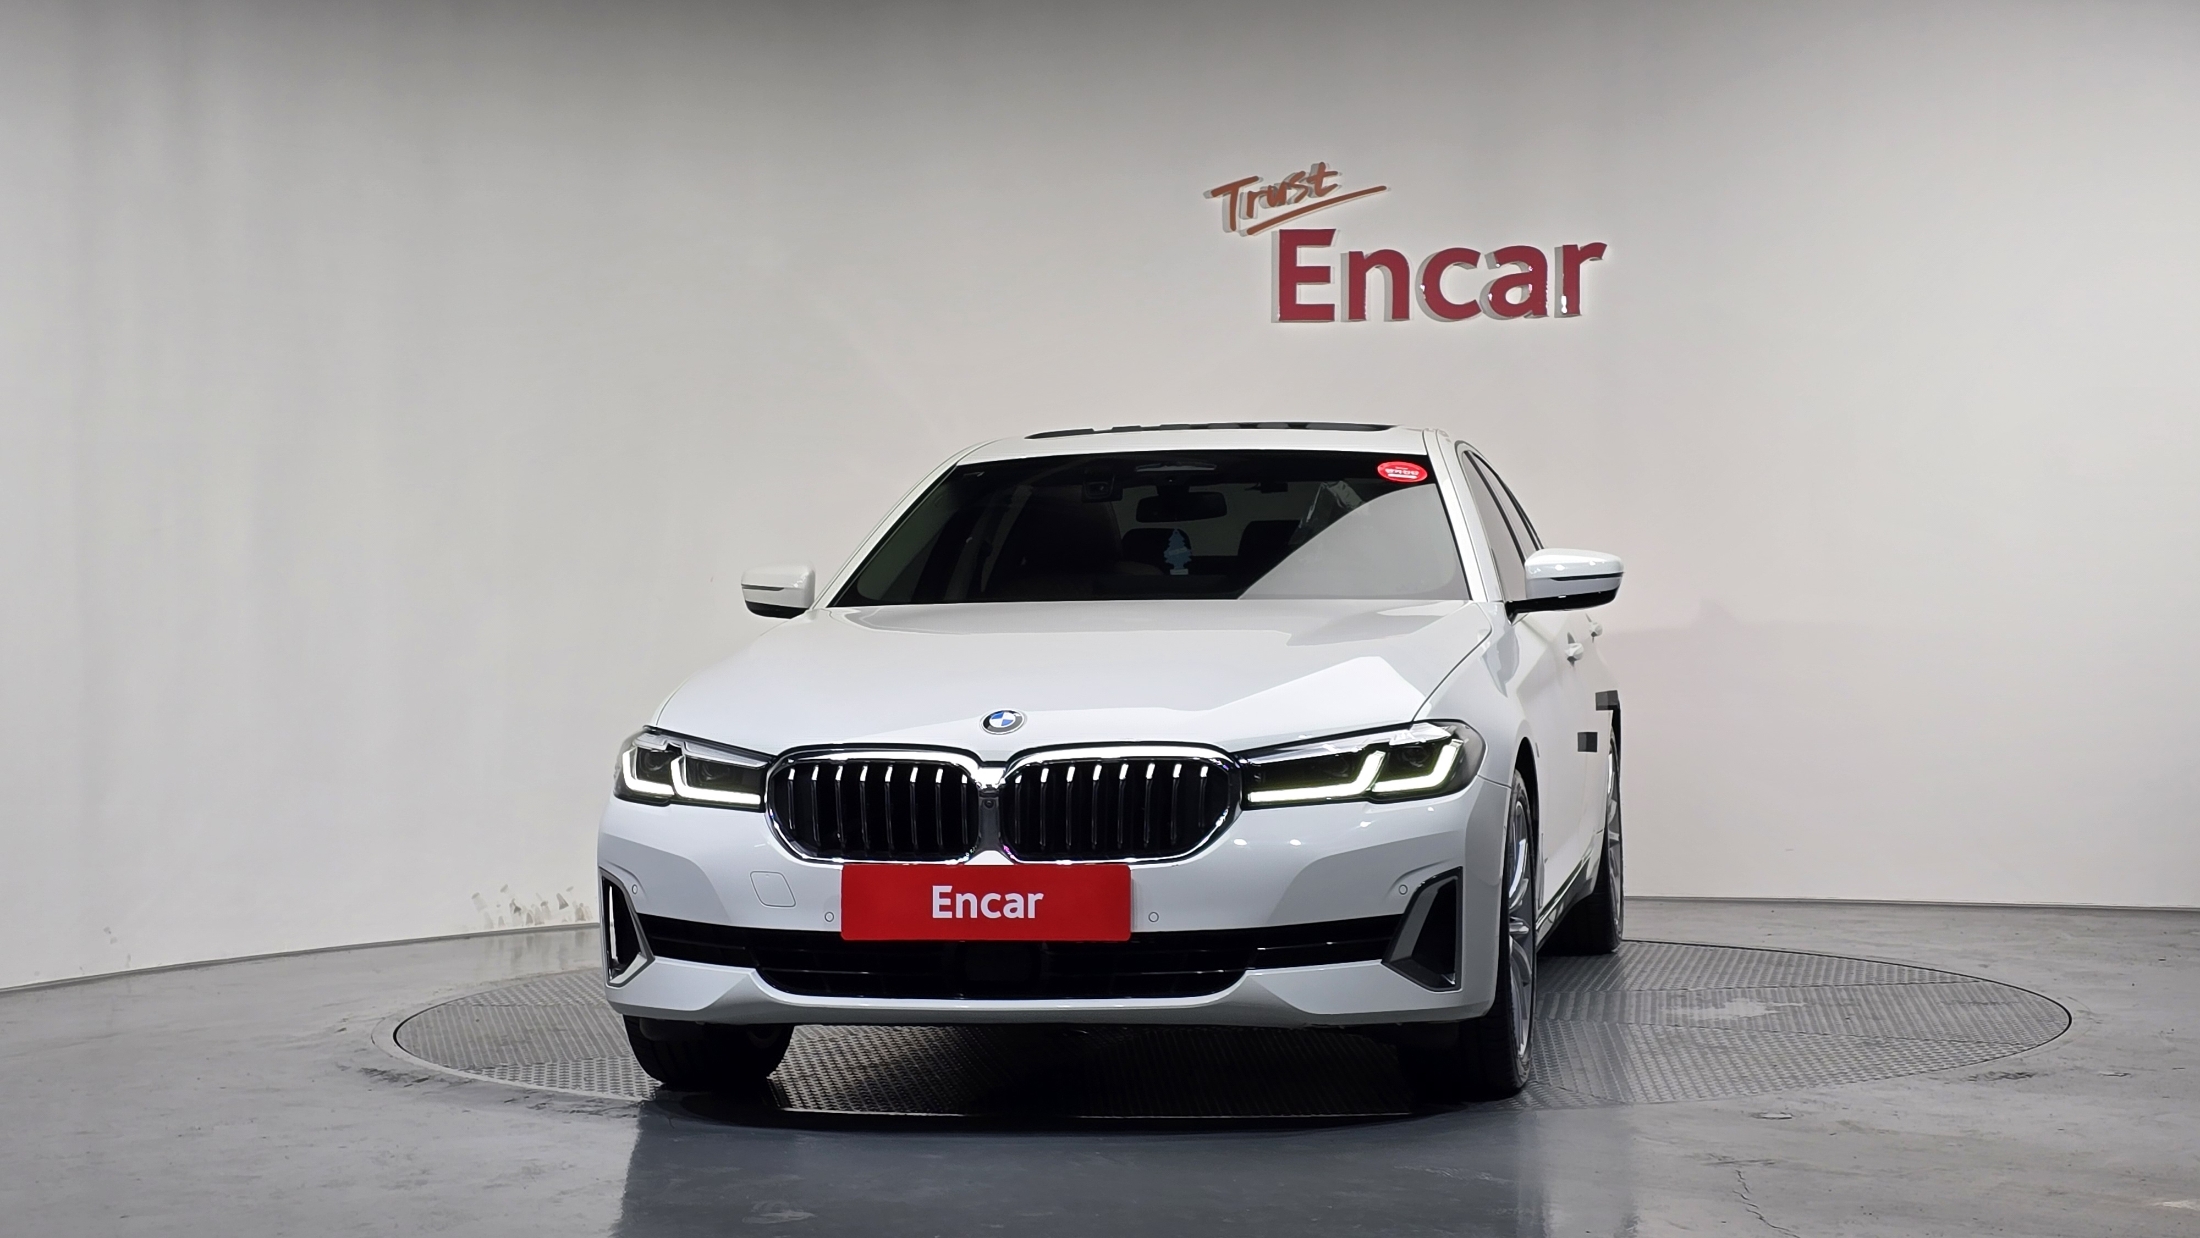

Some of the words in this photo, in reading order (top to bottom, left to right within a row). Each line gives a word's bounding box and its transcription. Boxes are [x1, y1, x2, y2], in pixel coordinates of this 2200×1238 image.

[1210, 162, 1339, 231] Trust
[1278, 228, 1608, 321] Encar
[932, 885, 1044, 919] Encar
